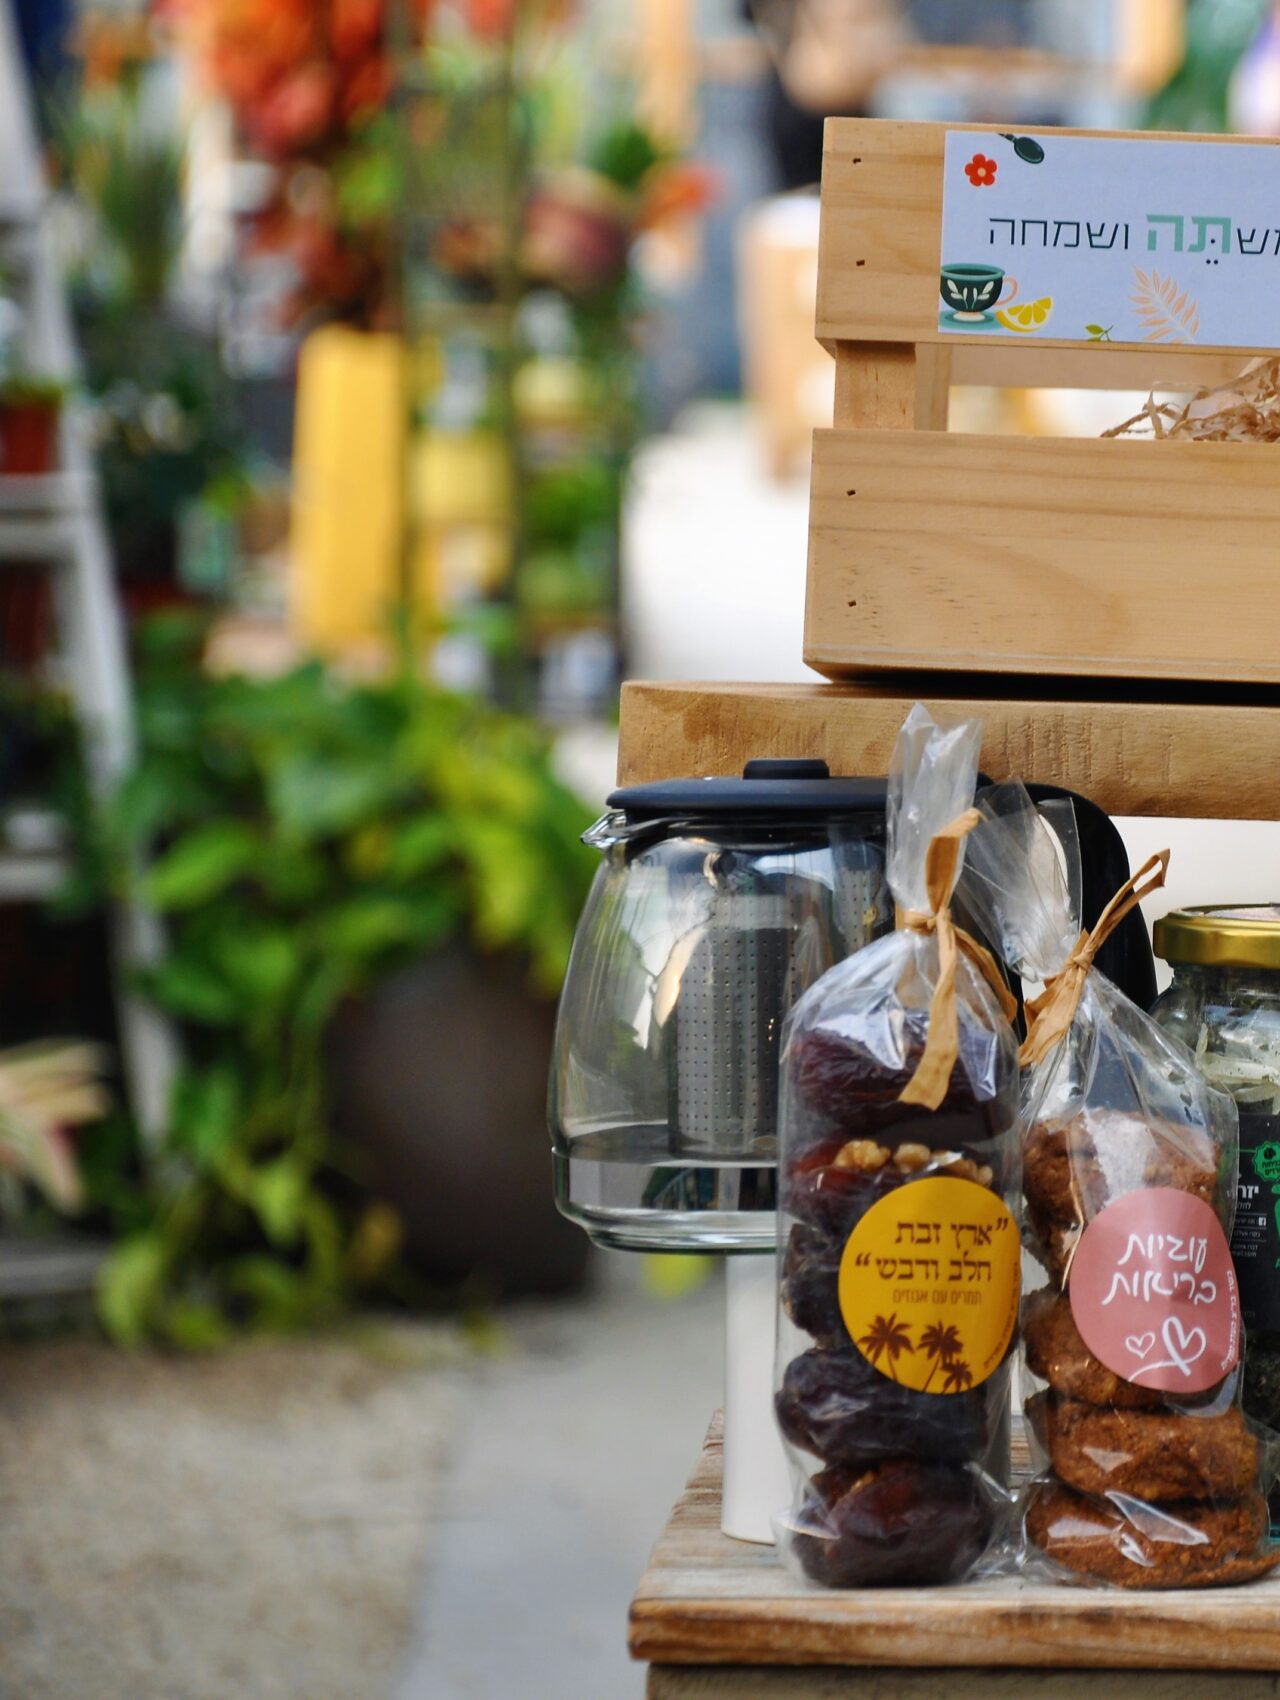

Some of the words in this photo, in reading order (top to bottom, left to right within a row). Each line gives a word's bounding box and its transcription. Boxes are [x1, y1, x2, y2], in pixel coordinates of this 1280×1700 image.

[989, 217, 1130, 250] ושמחה
[895, 1221, 941, 1244] זבת
[948, 1251, 992, 1282] חלב
[1117, 1232, 1208, 1275] עוגיות
[932, 1290, 948, 1304] עם
[1102, 1270, 1217, 1306] בריאות
